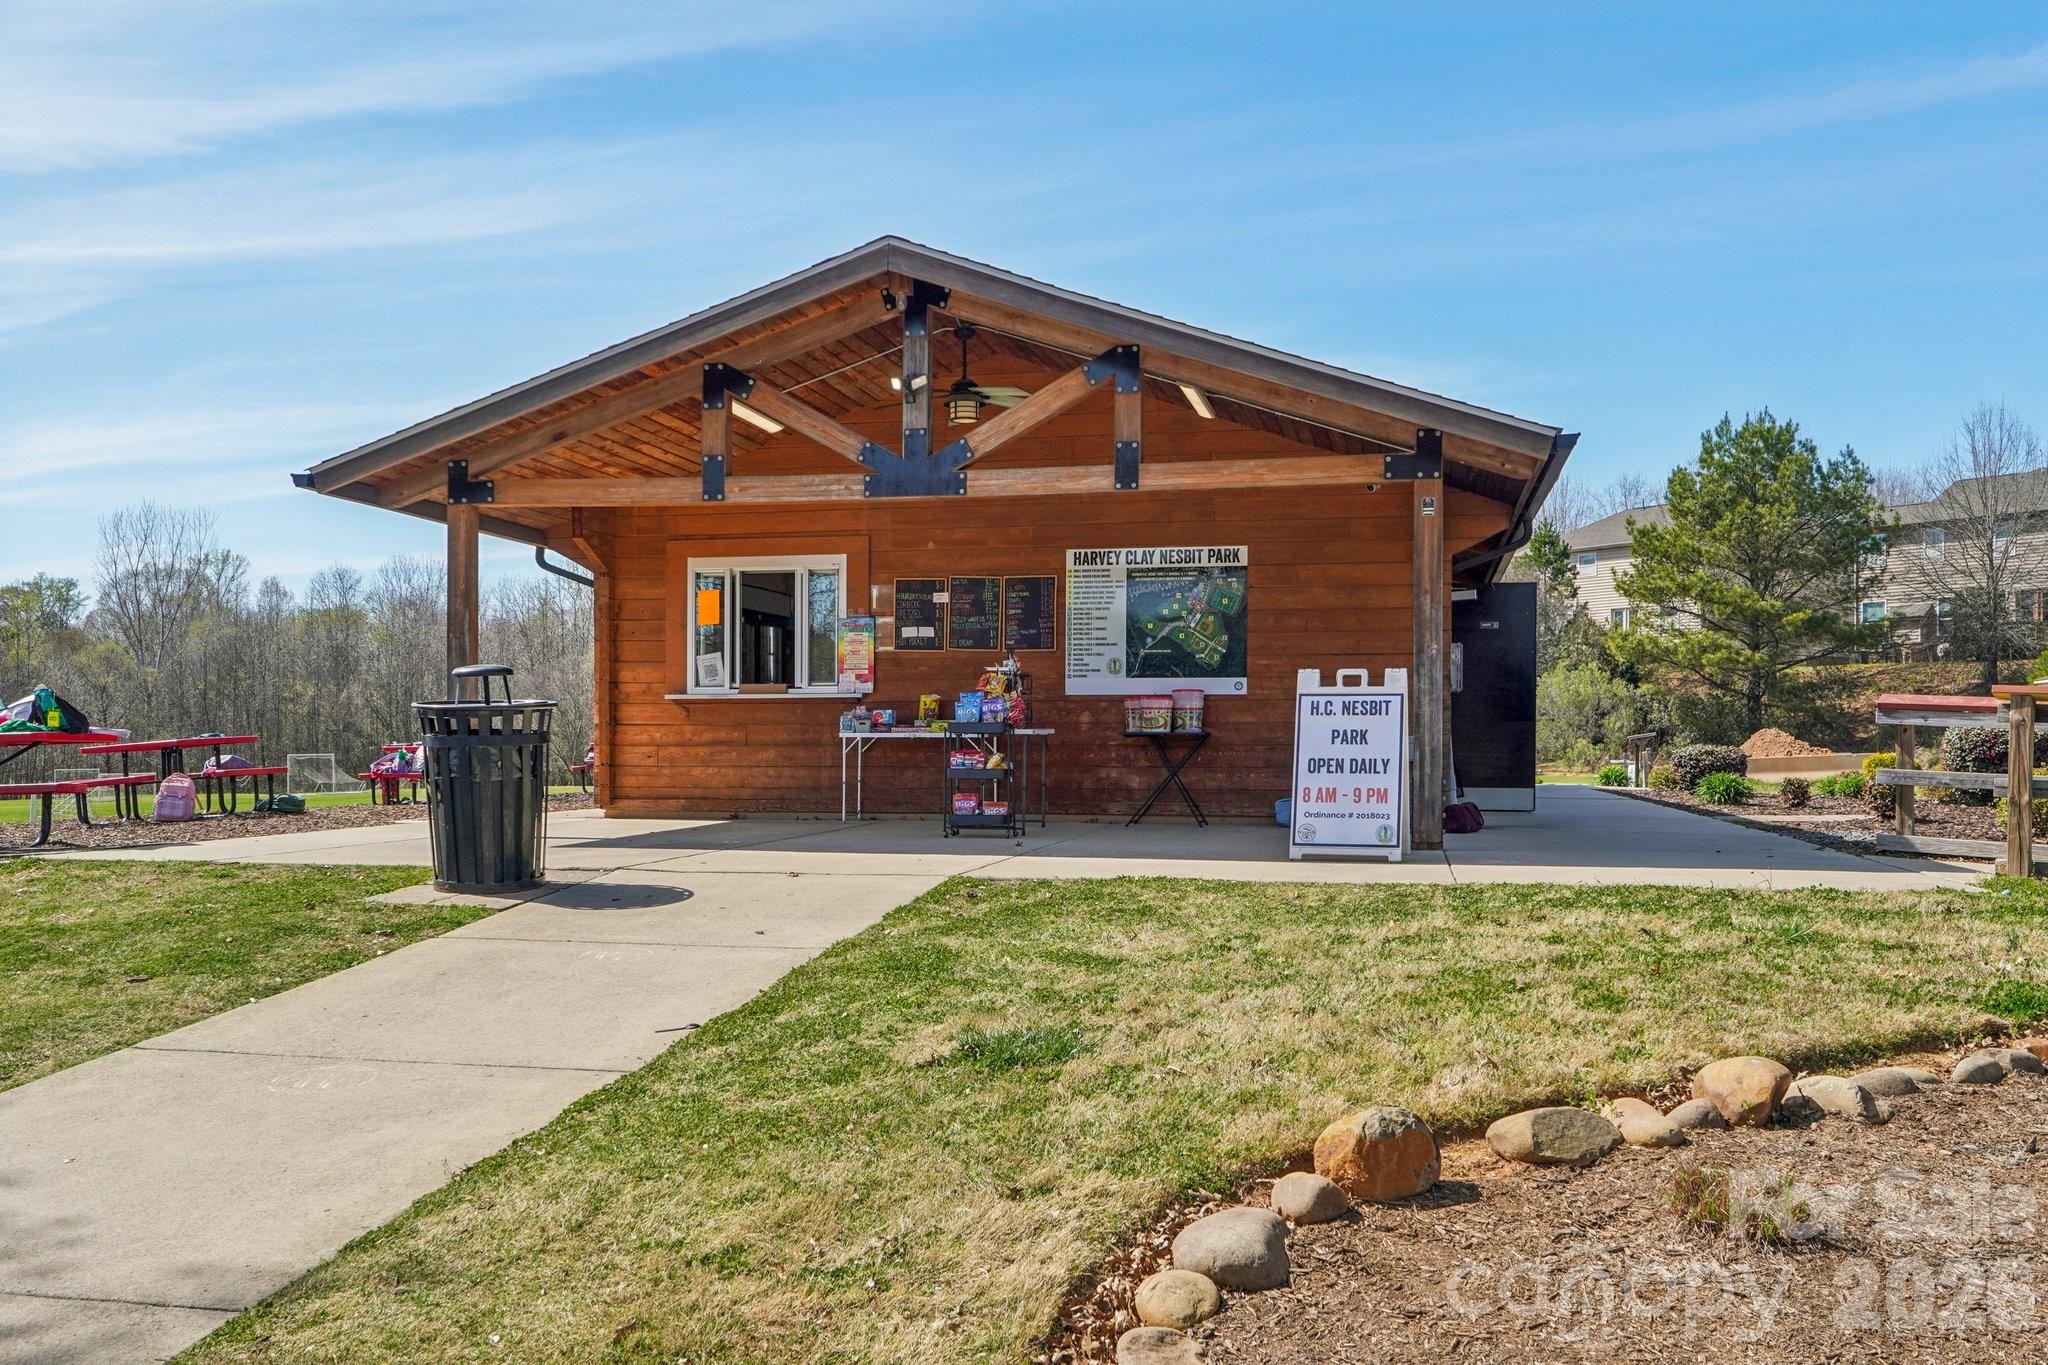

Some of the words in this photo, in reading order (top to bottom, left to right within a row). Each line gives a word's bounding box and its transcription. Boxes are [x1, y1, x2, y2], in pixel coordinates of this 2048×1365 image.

[1073, 551, 1122, 566] HARVEY
[1126, 550, 1155, 566] CLAY
[1160, 549, 1204, 564] NESBIT
[1208, 548, 1240, 563] PARK
[1310, 700, 1336, 716] H.C.
[1342, 700, 1392, 716] NESBIT
[1332, 730, 1368, 745] PARK
[1307, 758, 1344, 774] OPEN
[1350, 758, 1390, 774] DAILY
[1302, 787, 1310, 804] 8
[1315, 788, 1337, 804] AM
[1353, 788, 1362, 804] 9
[1366, 788, 1388, 804] PM
[1356, 812, 1390, 820] 2018023
